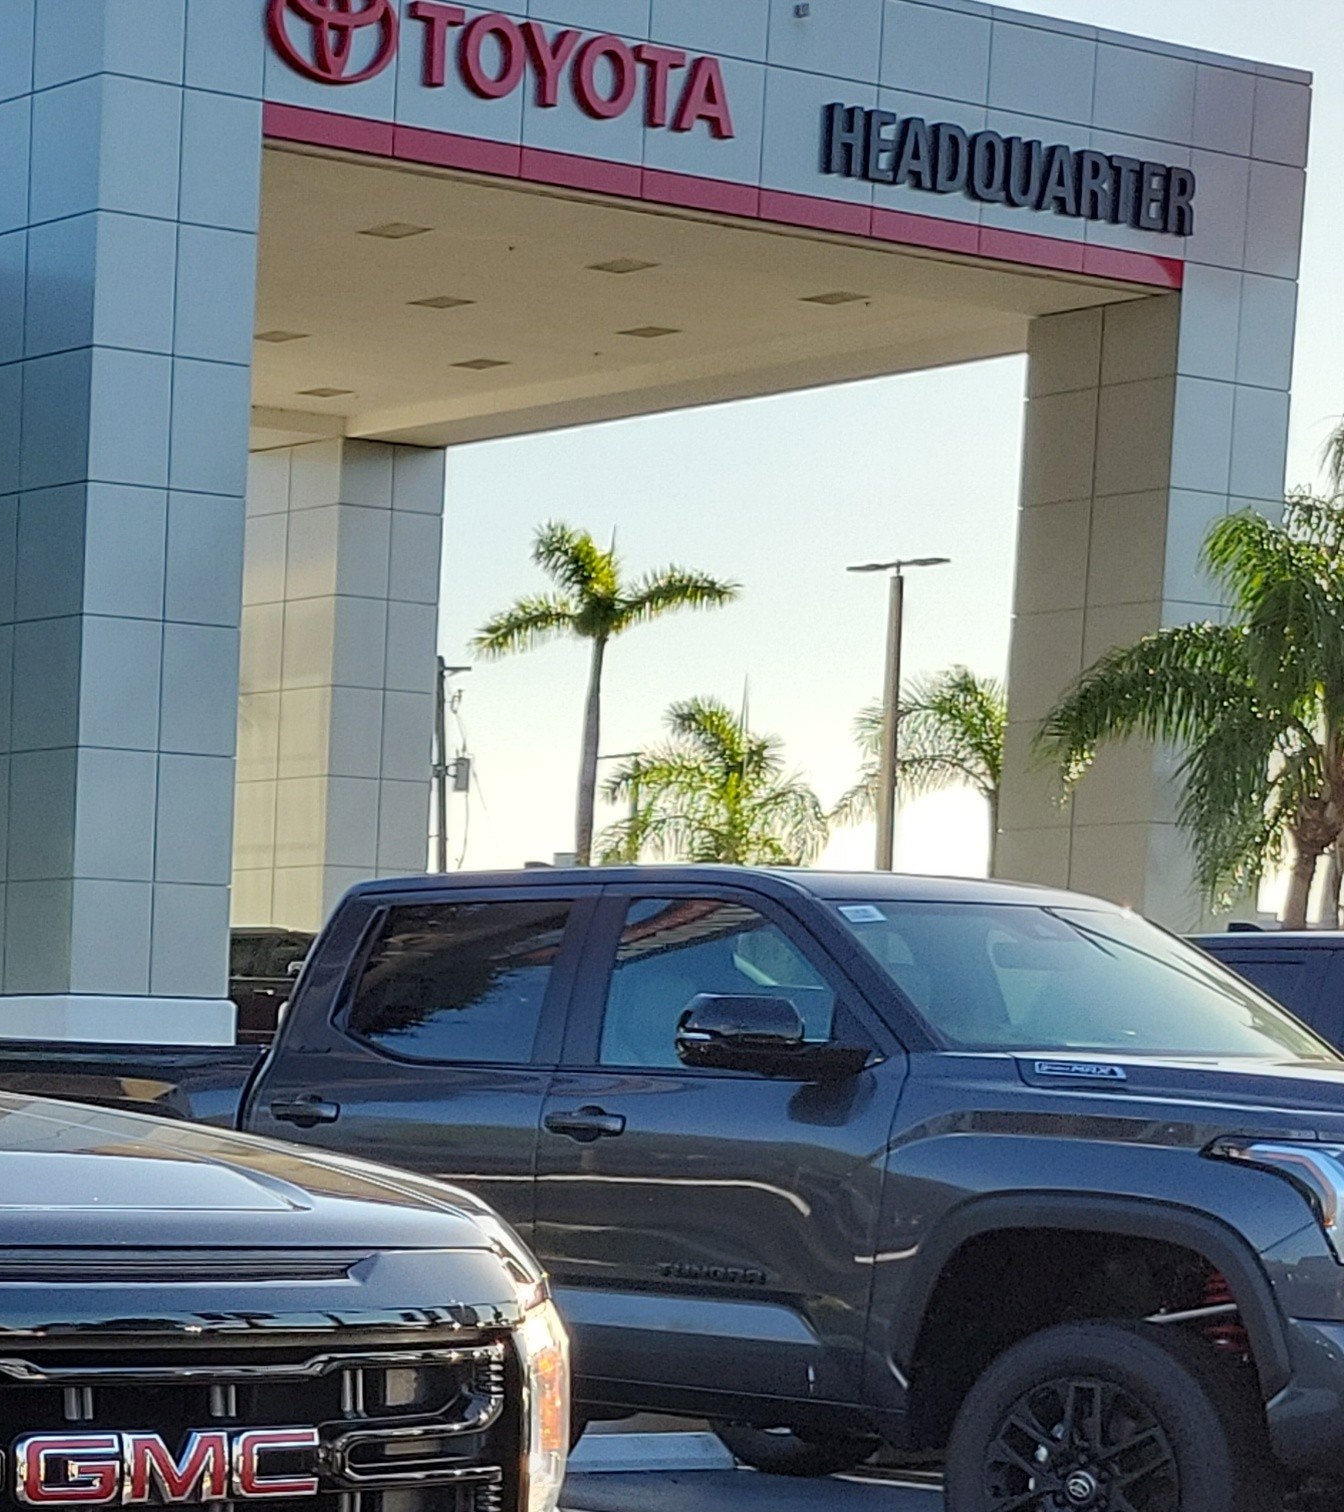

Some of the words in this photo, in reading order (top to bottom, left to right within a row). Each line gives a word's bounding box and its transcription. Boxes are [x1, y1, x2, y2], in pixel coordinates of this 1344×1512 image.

[409, 2, 735, 139] TOYOTA
[818, 102, 1197, 236] HEADQUARTER
[15, 1428, 319, 1505] GMC
